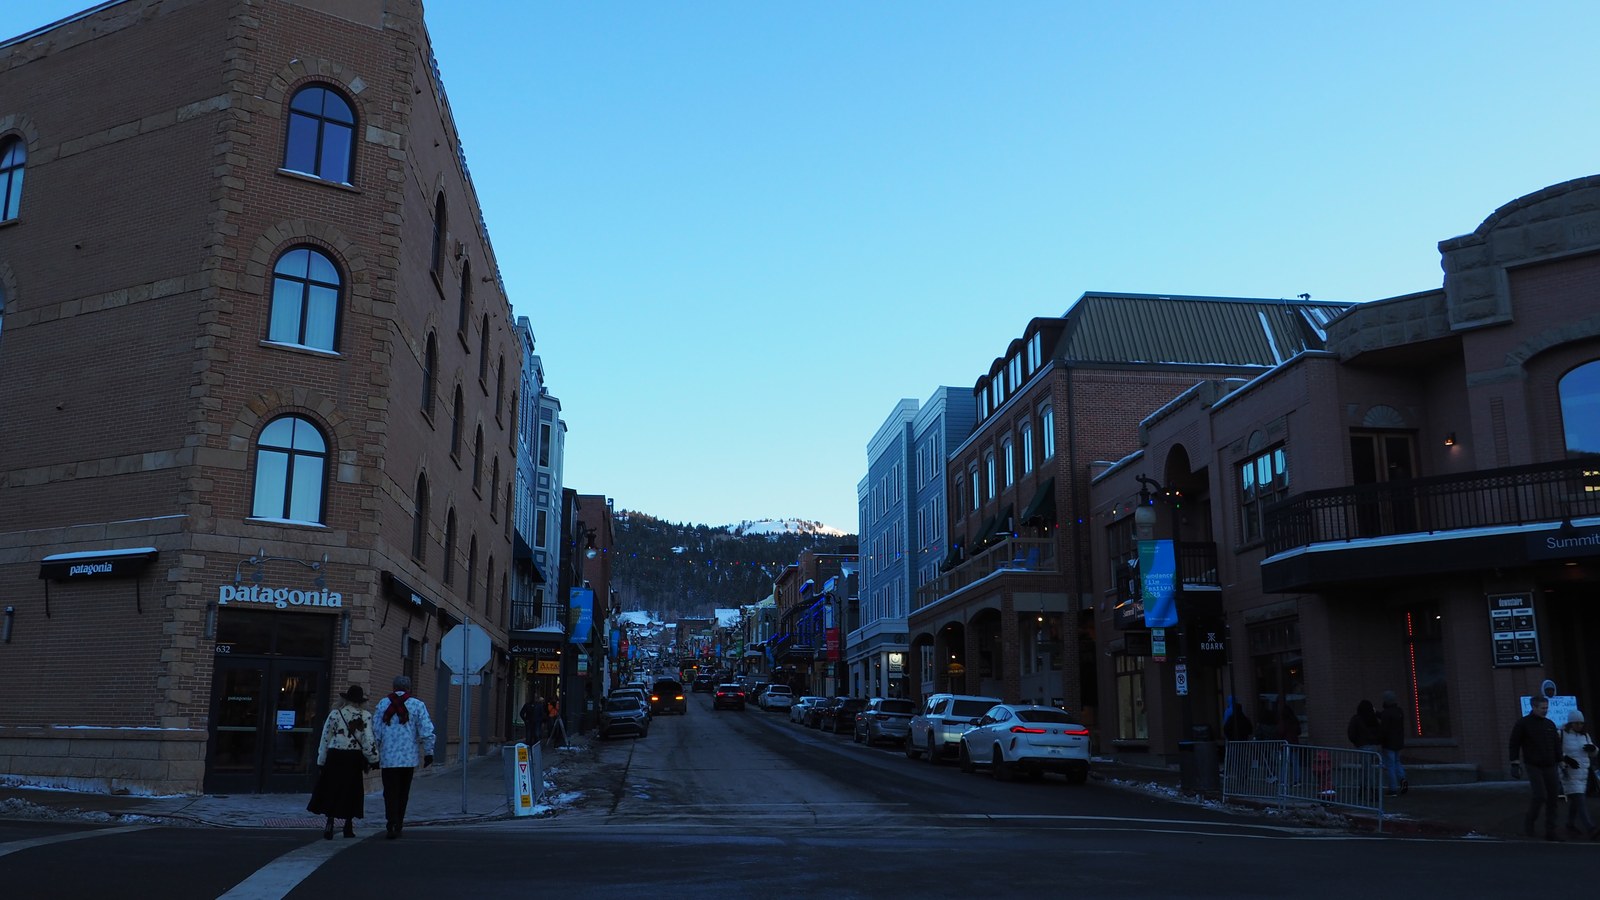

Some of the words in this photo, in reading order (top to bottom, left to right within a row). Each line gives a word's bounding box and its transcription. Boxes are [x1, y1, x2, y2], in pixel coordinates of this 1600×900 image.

[1546, 534, 1600, 549] Summit
[69, 562, 113, 577] patagonia
[218, 584, 342, 609] patagonia
[216, 645, 231, 653] 632
[1200, 642, 1224, 650] ROARK
